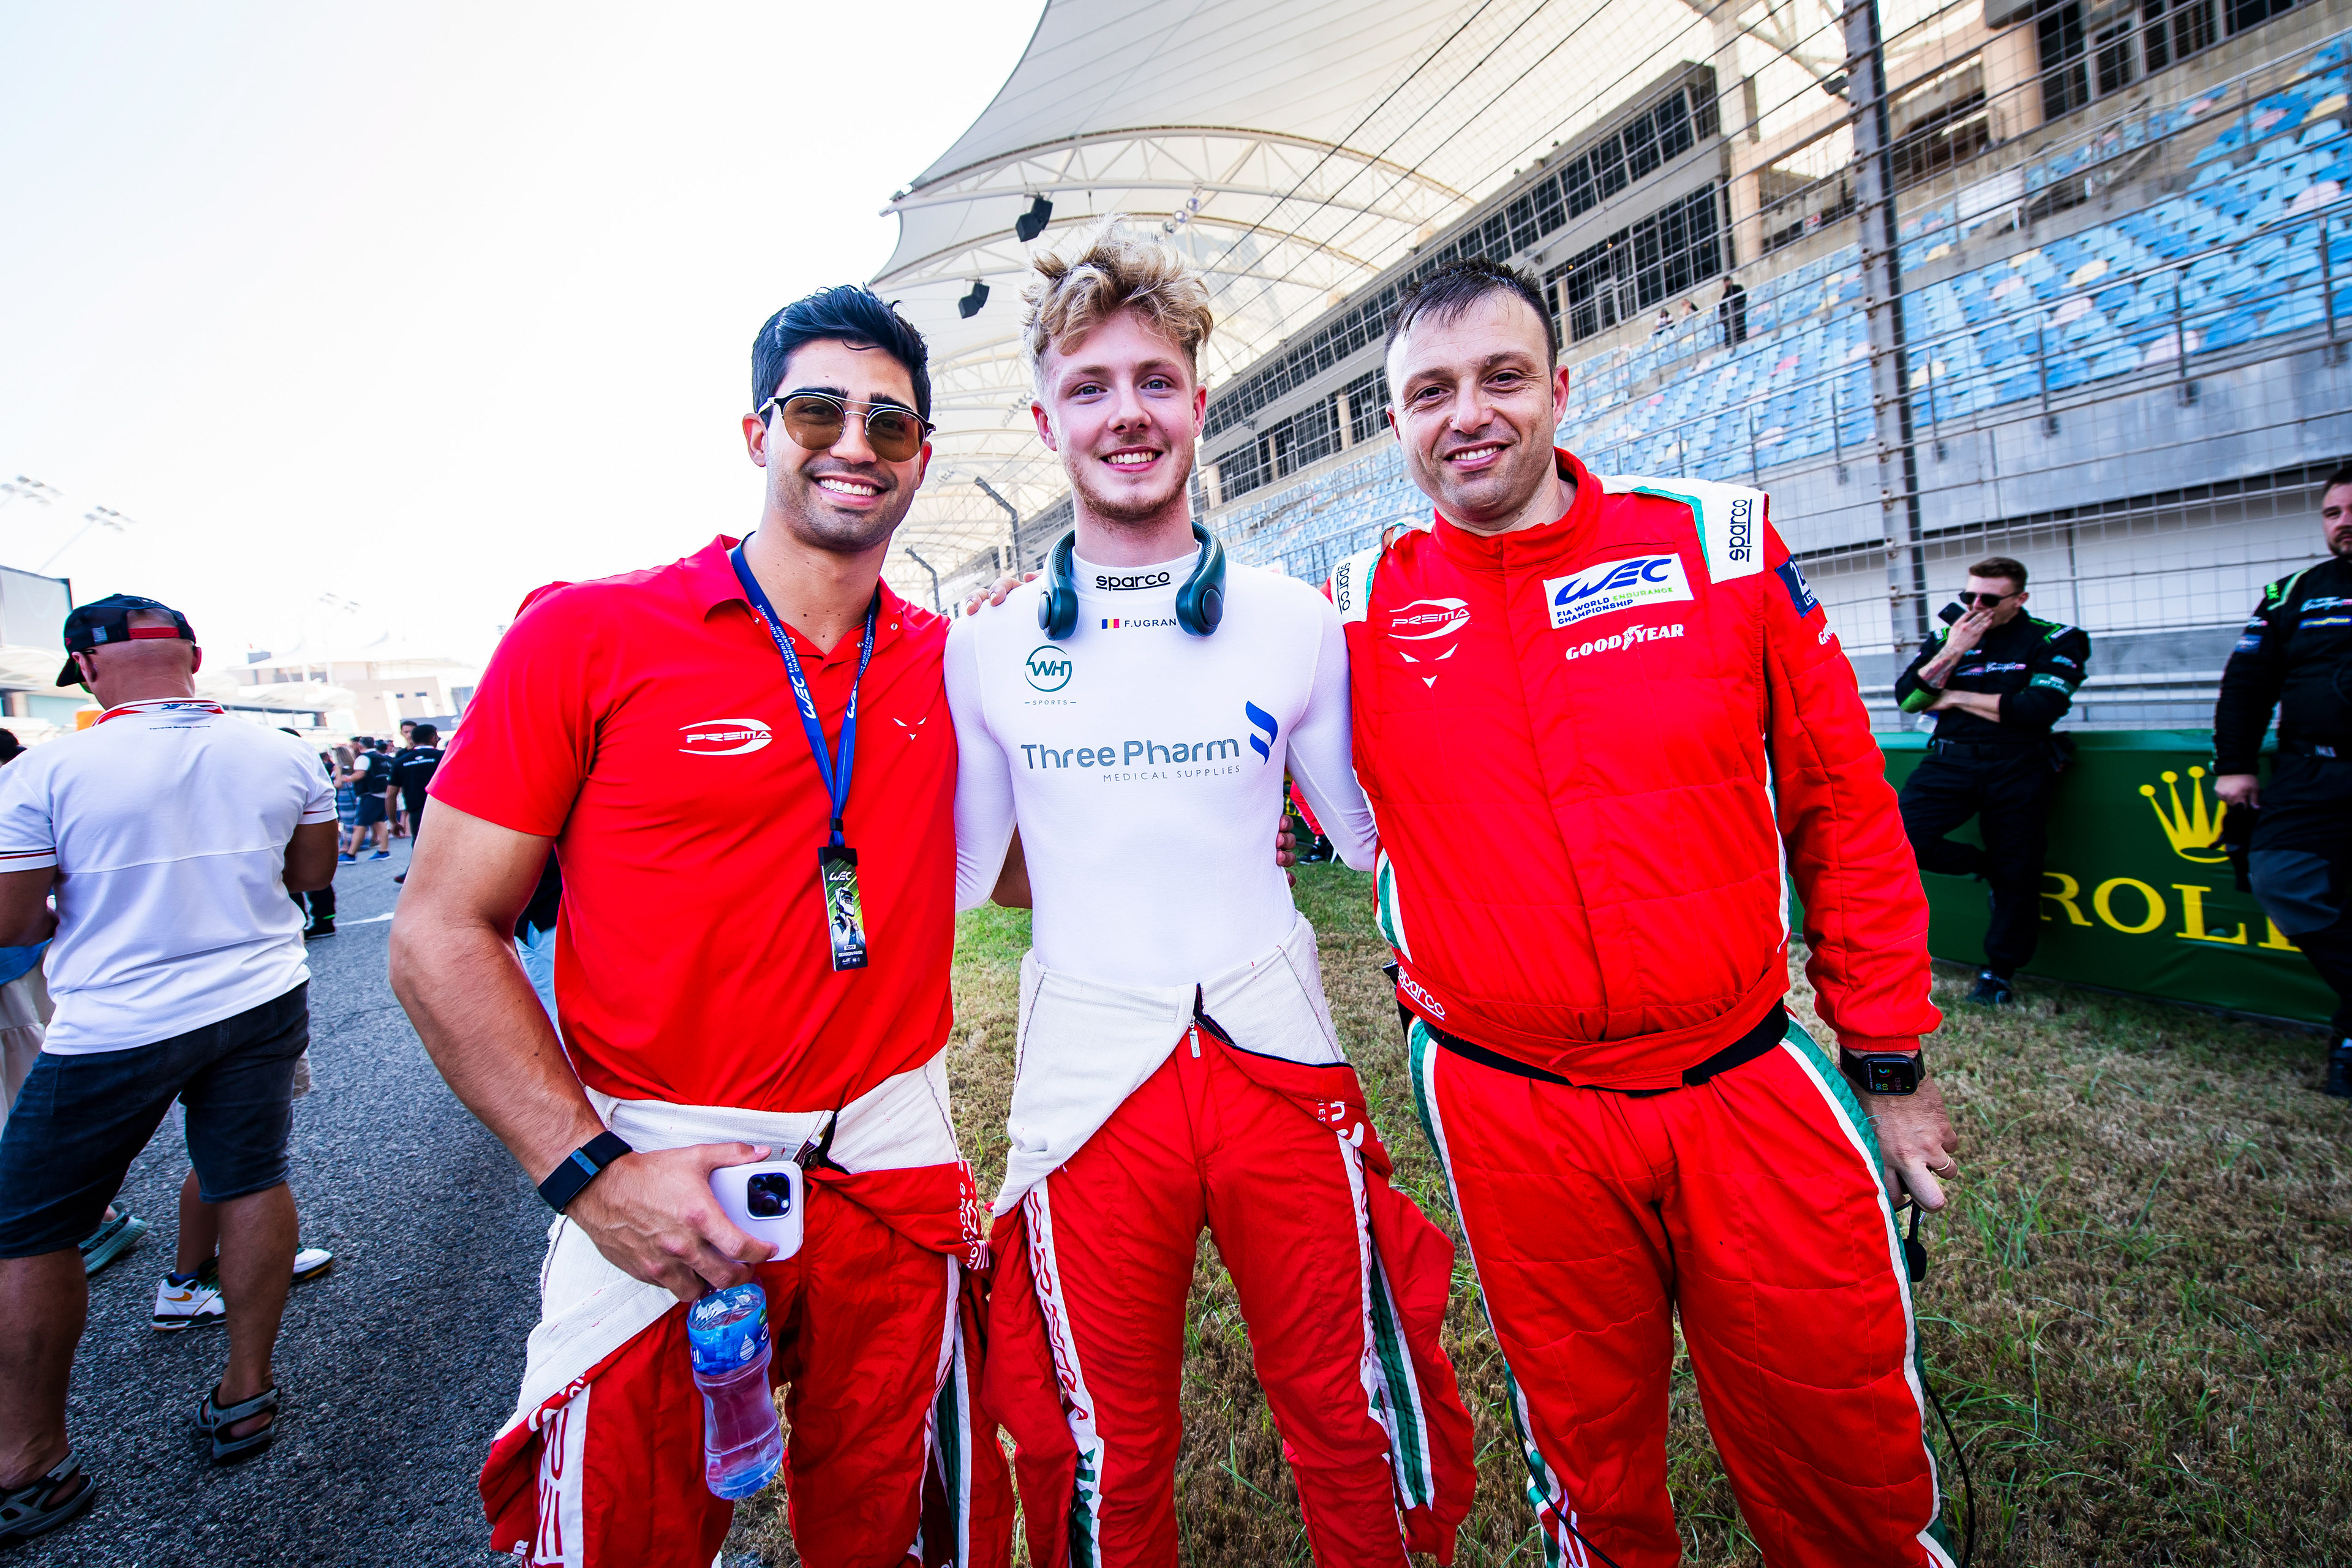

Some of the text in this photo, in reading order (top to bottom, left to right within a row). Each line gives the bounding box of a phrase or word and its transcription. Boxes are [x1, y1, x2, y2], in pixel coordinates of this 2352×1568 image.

[1729, 499, 1752, 562] sparco
[1096, 571, 1170, 591] sparco
[1336, 562, 1351, 612] sparco
[1555, 559, 1672, 606] WEC
[1558, 599, 1634, 625] CHAMPIONSHIP
[1575, 597, 1610, 612] WORLD
[1613, 587, 1673, 601] ENDURANCE
[1125, 619, 1176, 627] F.UGRAN
[1392, 608, 1470, 627] PREMA
[776, 625, 800, 672] CHAMPIONSHIP
[777, 639, 790, 661] WORLD
[1566, 624, 1684, 660] GOODYEAR
[791, 676, 816, 719] WEC
[687, 730, 772, 744] PREMA
[1020, 739, 1240, 769] Three Pharm
[1103, 765, 1240, 782] MEDICAL SUPPLIES
[829, 871, 852, 881] WEC
[1398, 966, 1446, 1020] sparco
